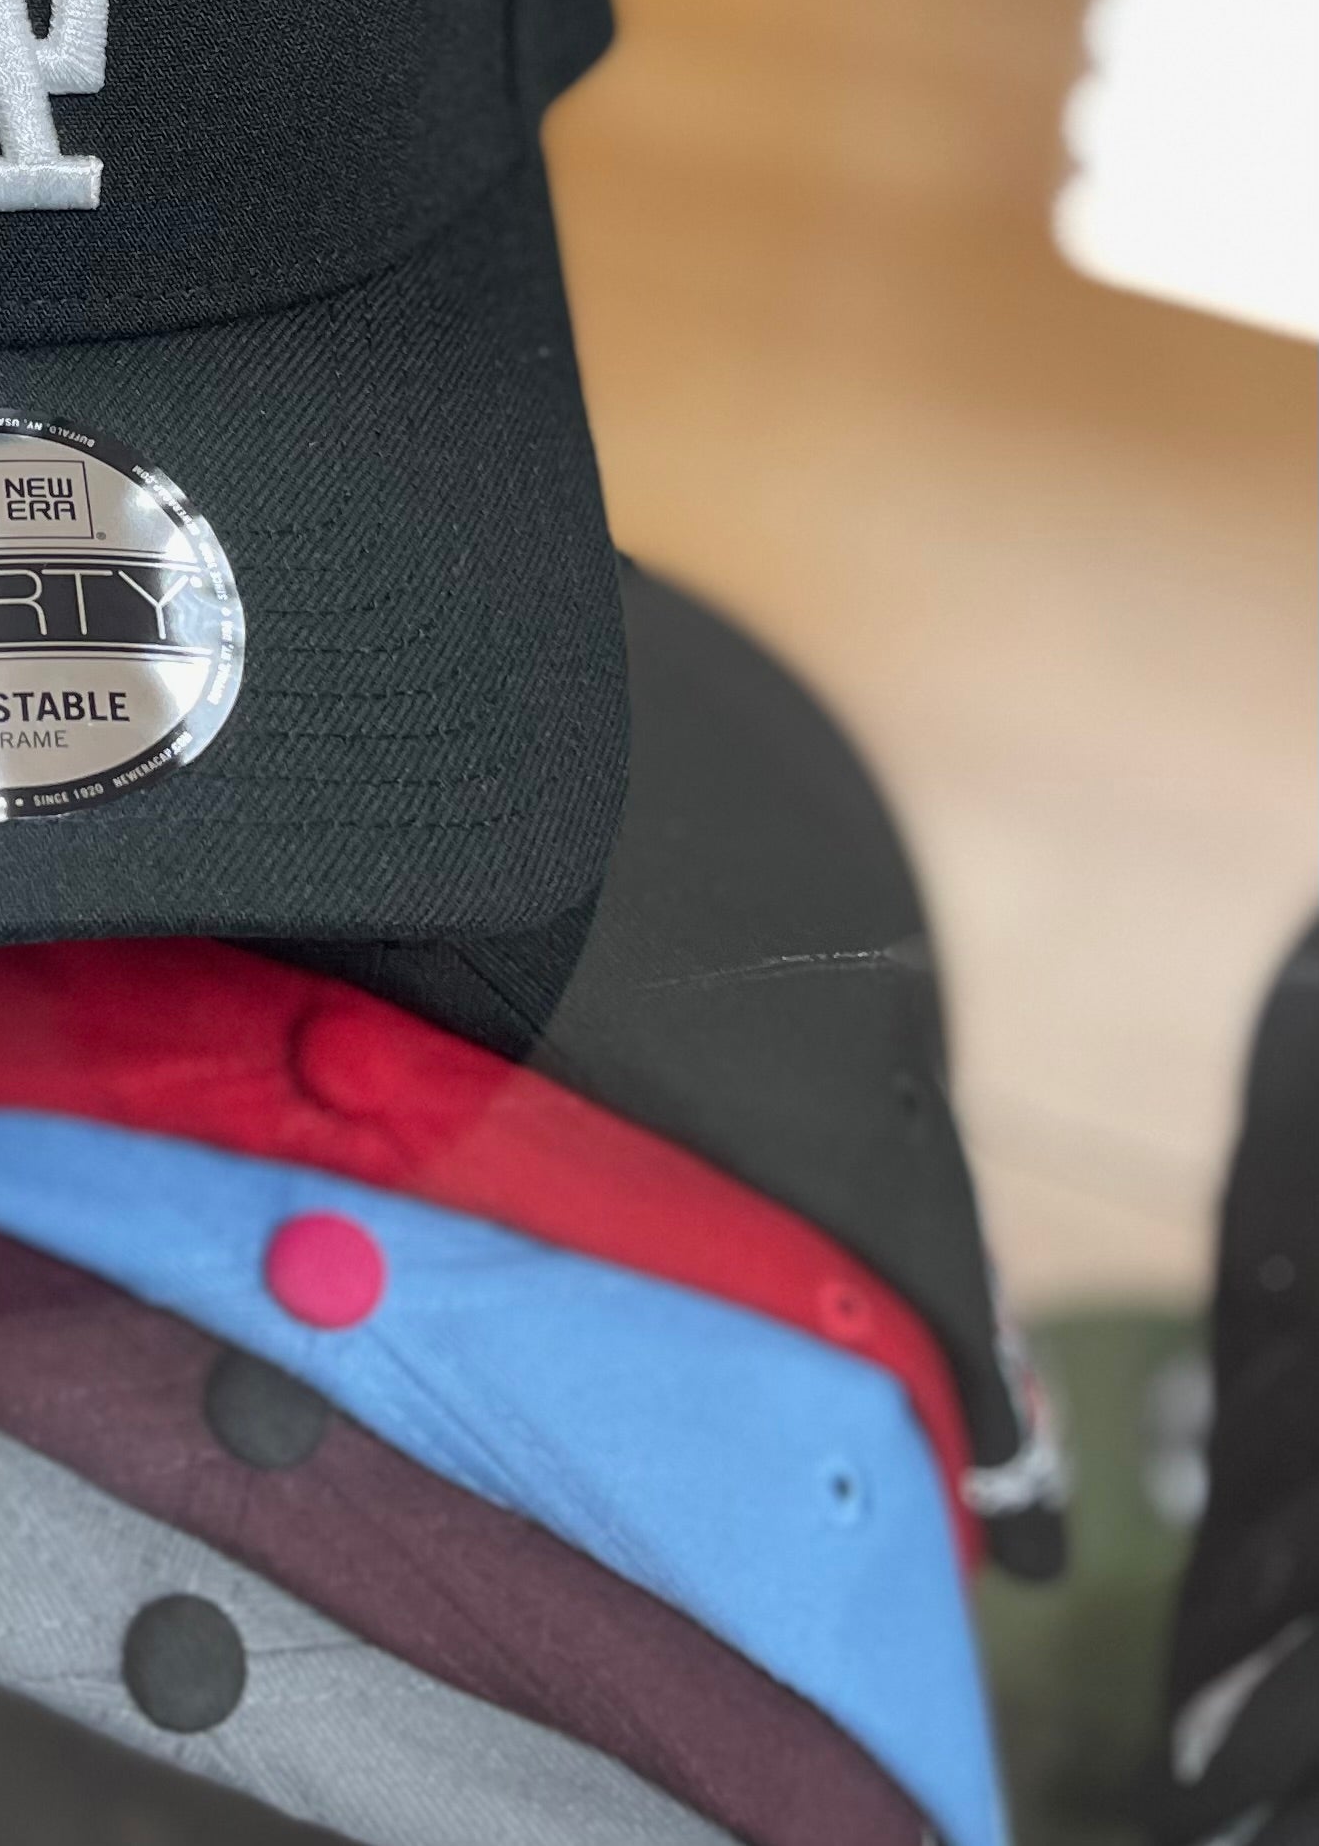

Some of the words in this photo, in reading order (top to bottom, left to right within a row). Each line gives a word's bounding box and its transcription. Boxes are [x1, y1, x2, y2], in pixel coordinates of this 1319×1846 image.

[4, 477, 72, 499] NEW
[7, 499, 77, 521] ERA
[34, 791, 70, 807] SINCE
